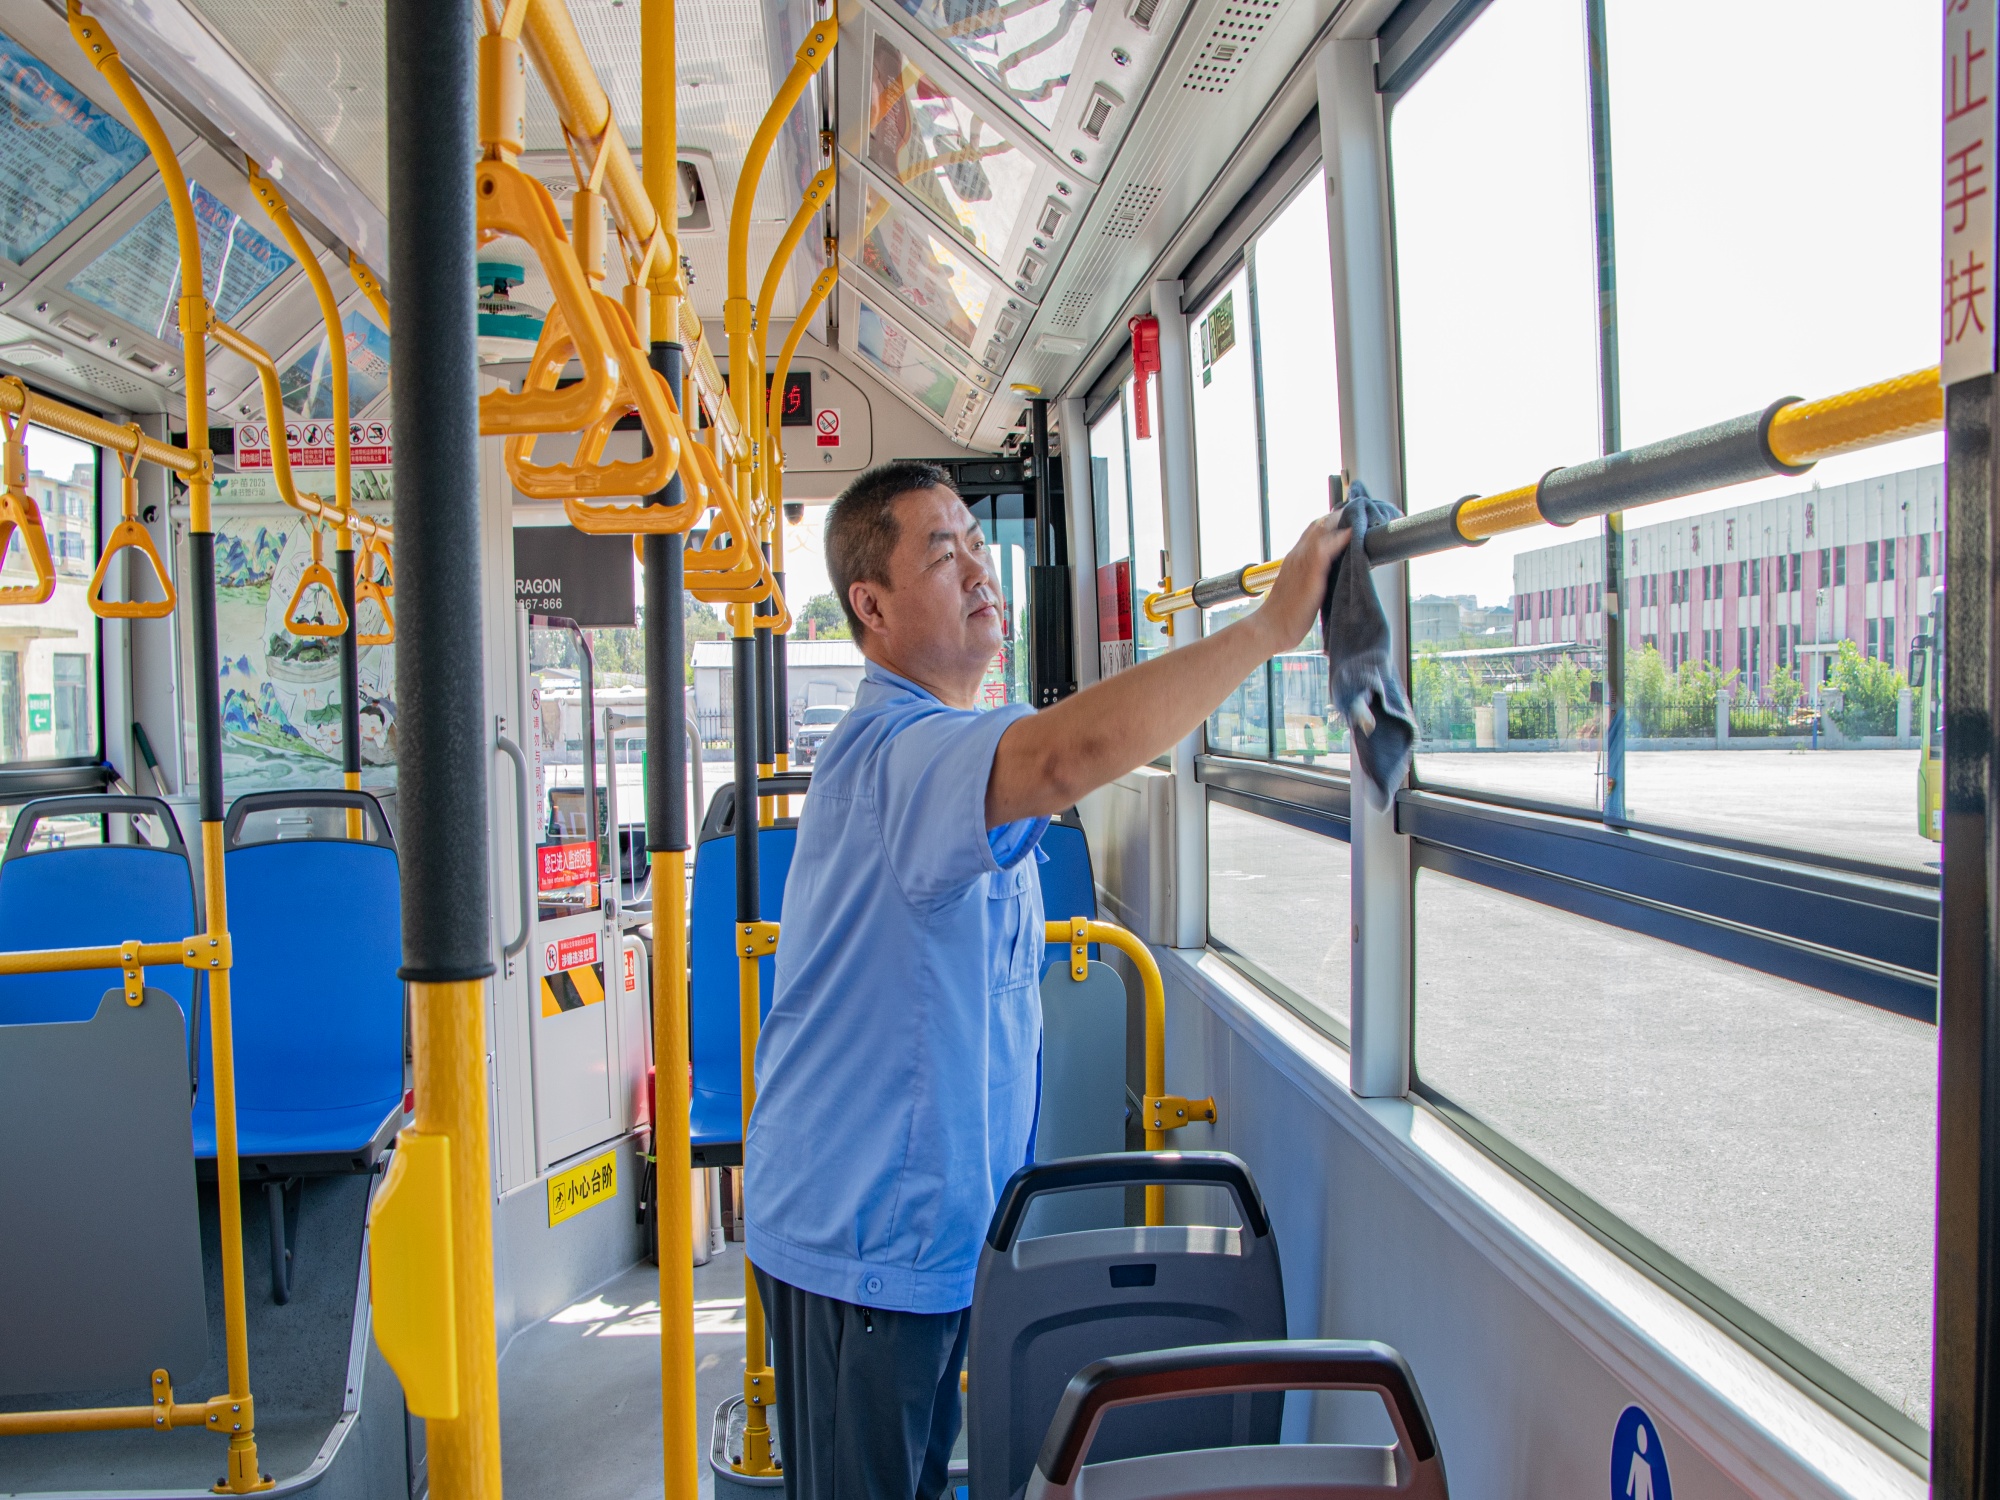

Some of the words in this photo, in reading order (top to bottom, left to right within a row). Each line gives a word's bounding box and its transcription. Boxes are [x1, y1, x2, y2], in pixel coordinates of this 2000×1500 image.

[1945, 0, 1988, 346] 止手扶
[515, 578, 561, 594] RAGON
[515, 598, 563, 610] 67-866
[544, 848, 592, 874] 您已进入监控区域
[561, 947, 595, 967] 涉嫌违法犯罪
[567, 1162, 613, 1205] 小心台阶
